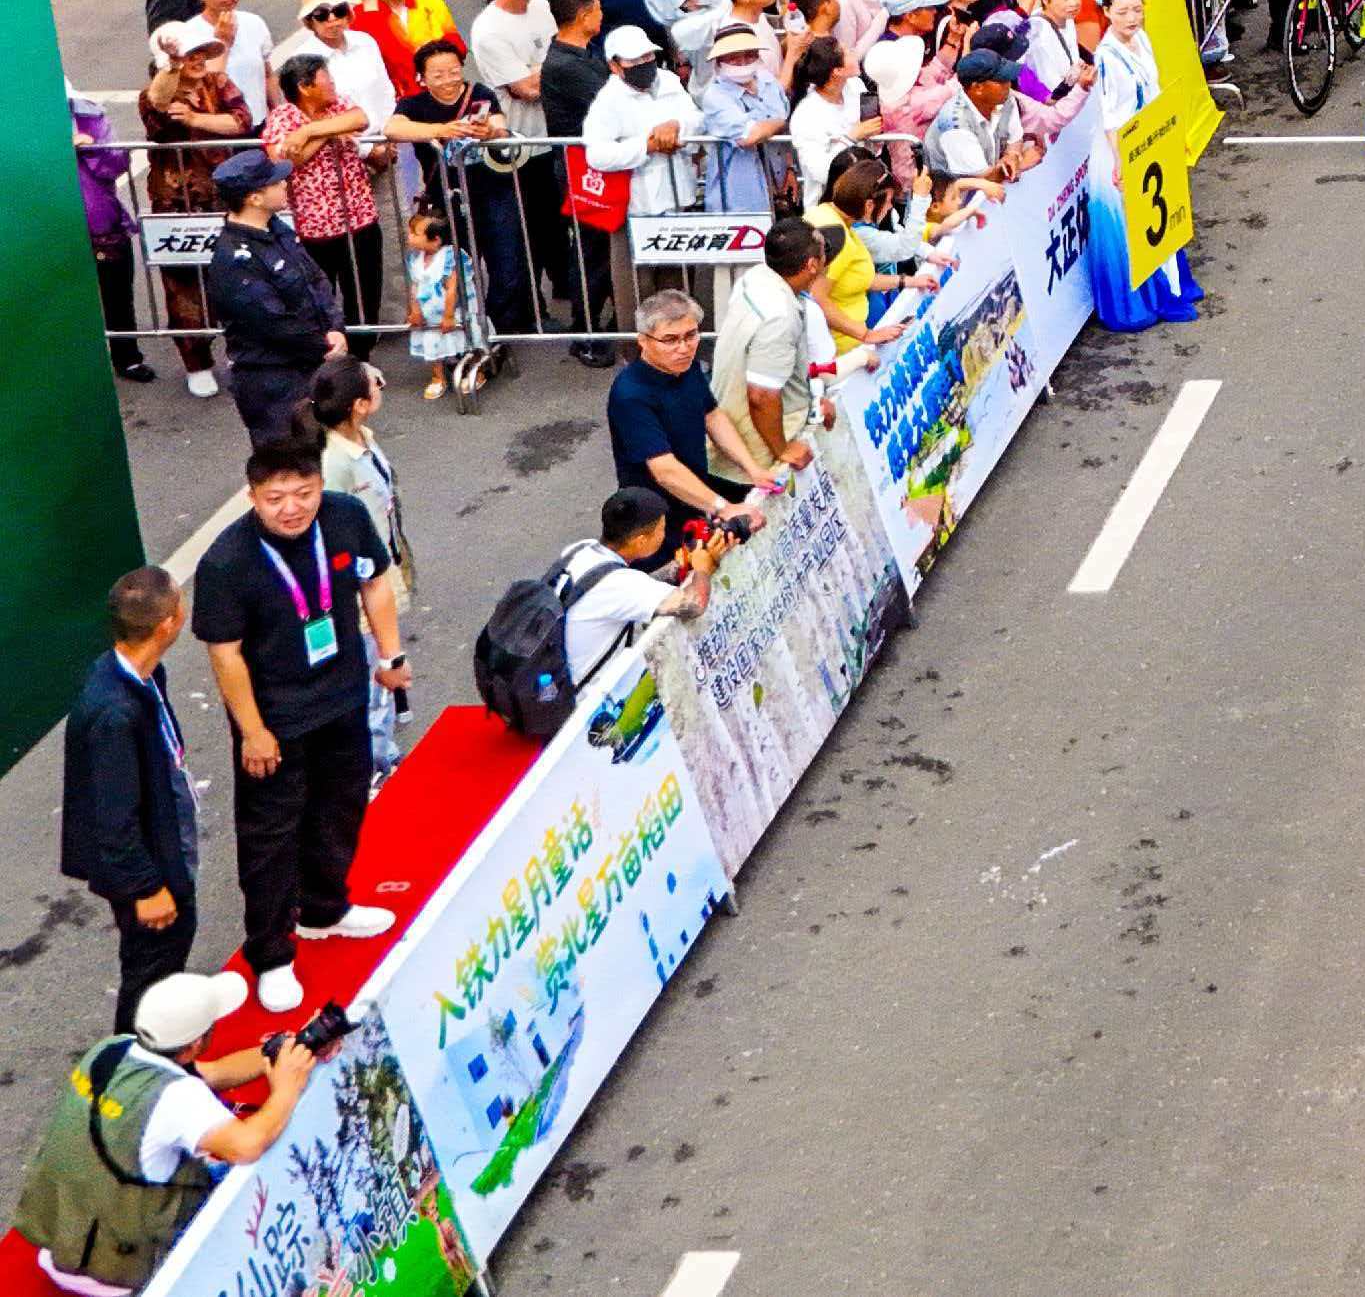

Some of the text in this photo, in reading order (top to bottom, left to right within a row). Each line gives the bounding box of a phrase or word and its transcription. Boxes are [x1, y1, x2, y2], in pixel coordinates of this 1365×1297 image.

[153, 233, 218, 253] 大正体
[641, 233, 733, 252] 大正体育
[1045, 186, 1091, 296] 大正体
[1142, 160, 1168, 248] 3
[433, 800, 595, 1050] 入铁力星月童话
[535, 771, 686, 1010] 赏北星万亩稻田
